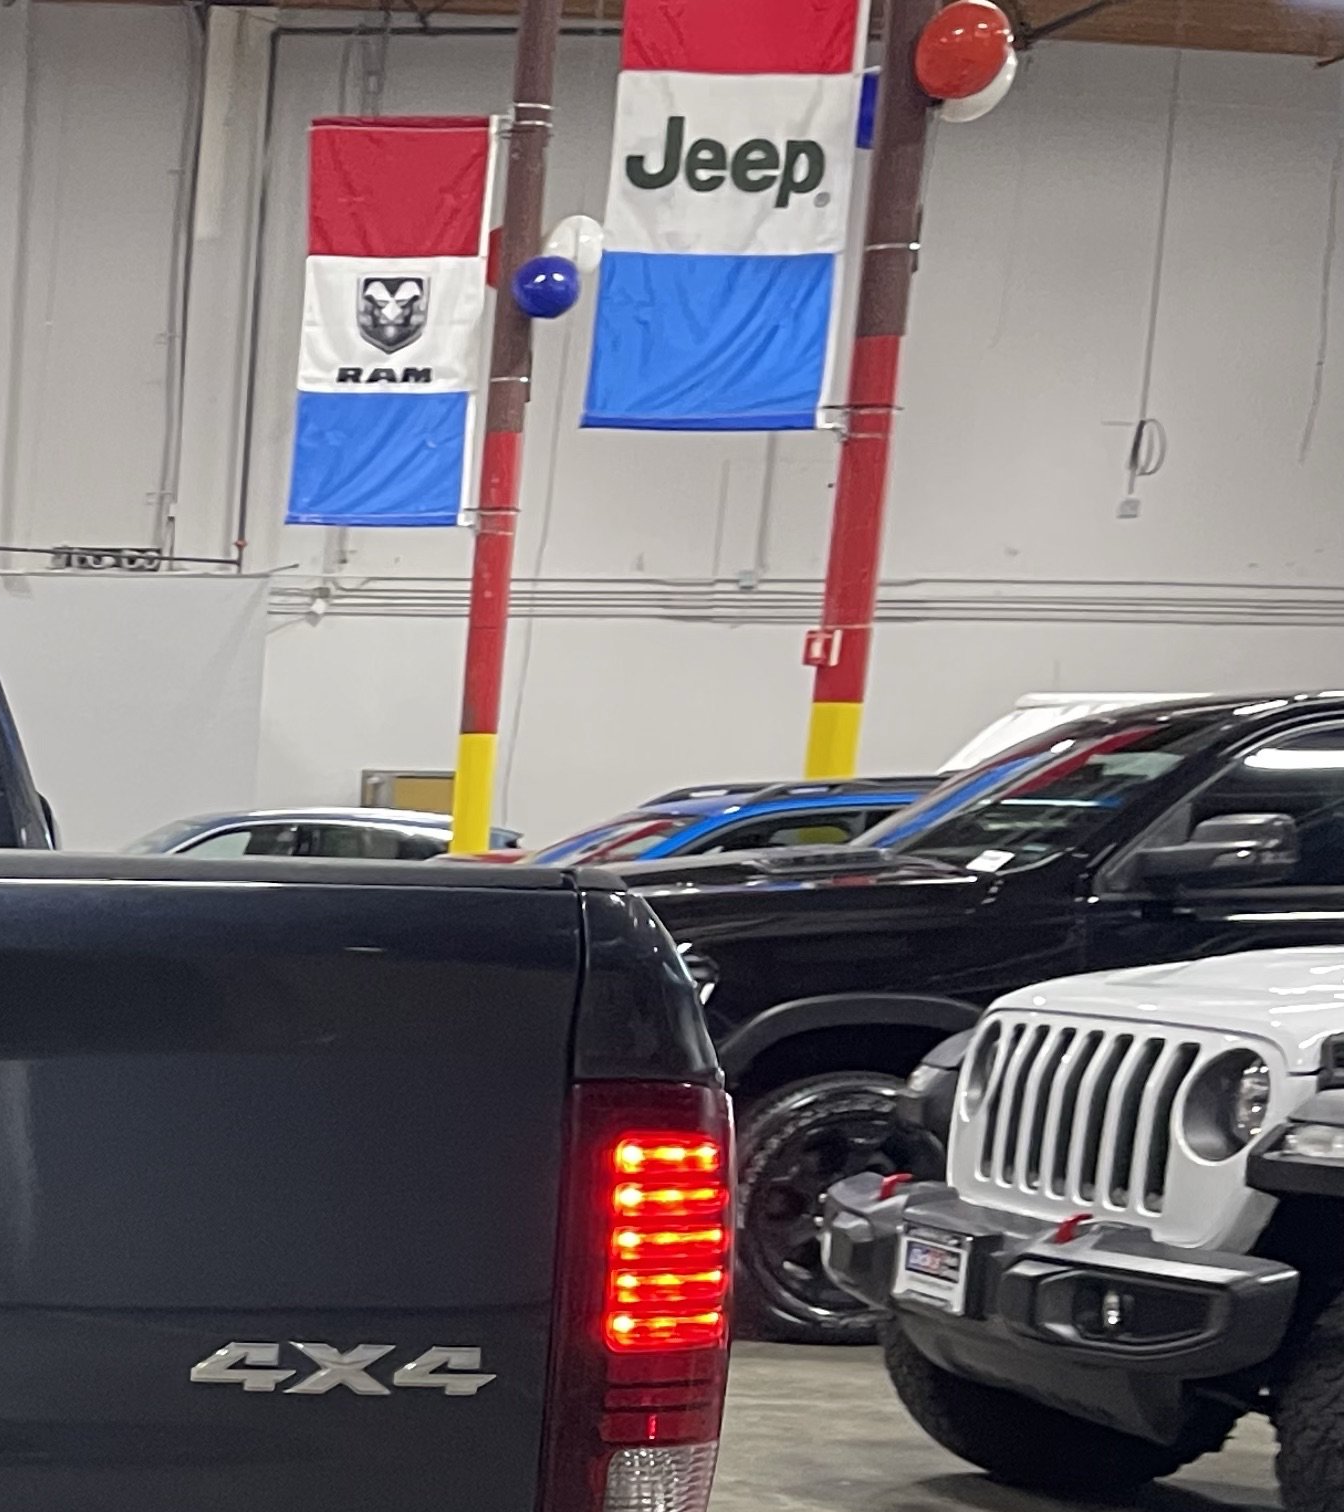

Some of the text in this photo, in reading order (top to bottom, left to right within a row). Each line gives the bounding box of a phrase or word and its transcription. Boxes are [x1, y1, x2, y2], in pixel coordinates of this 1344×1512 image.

[626, 116, 825, 208] Jeep
[336, 367, 433, 383] RAM
[190, 1341, 497, 1396] 4X4
